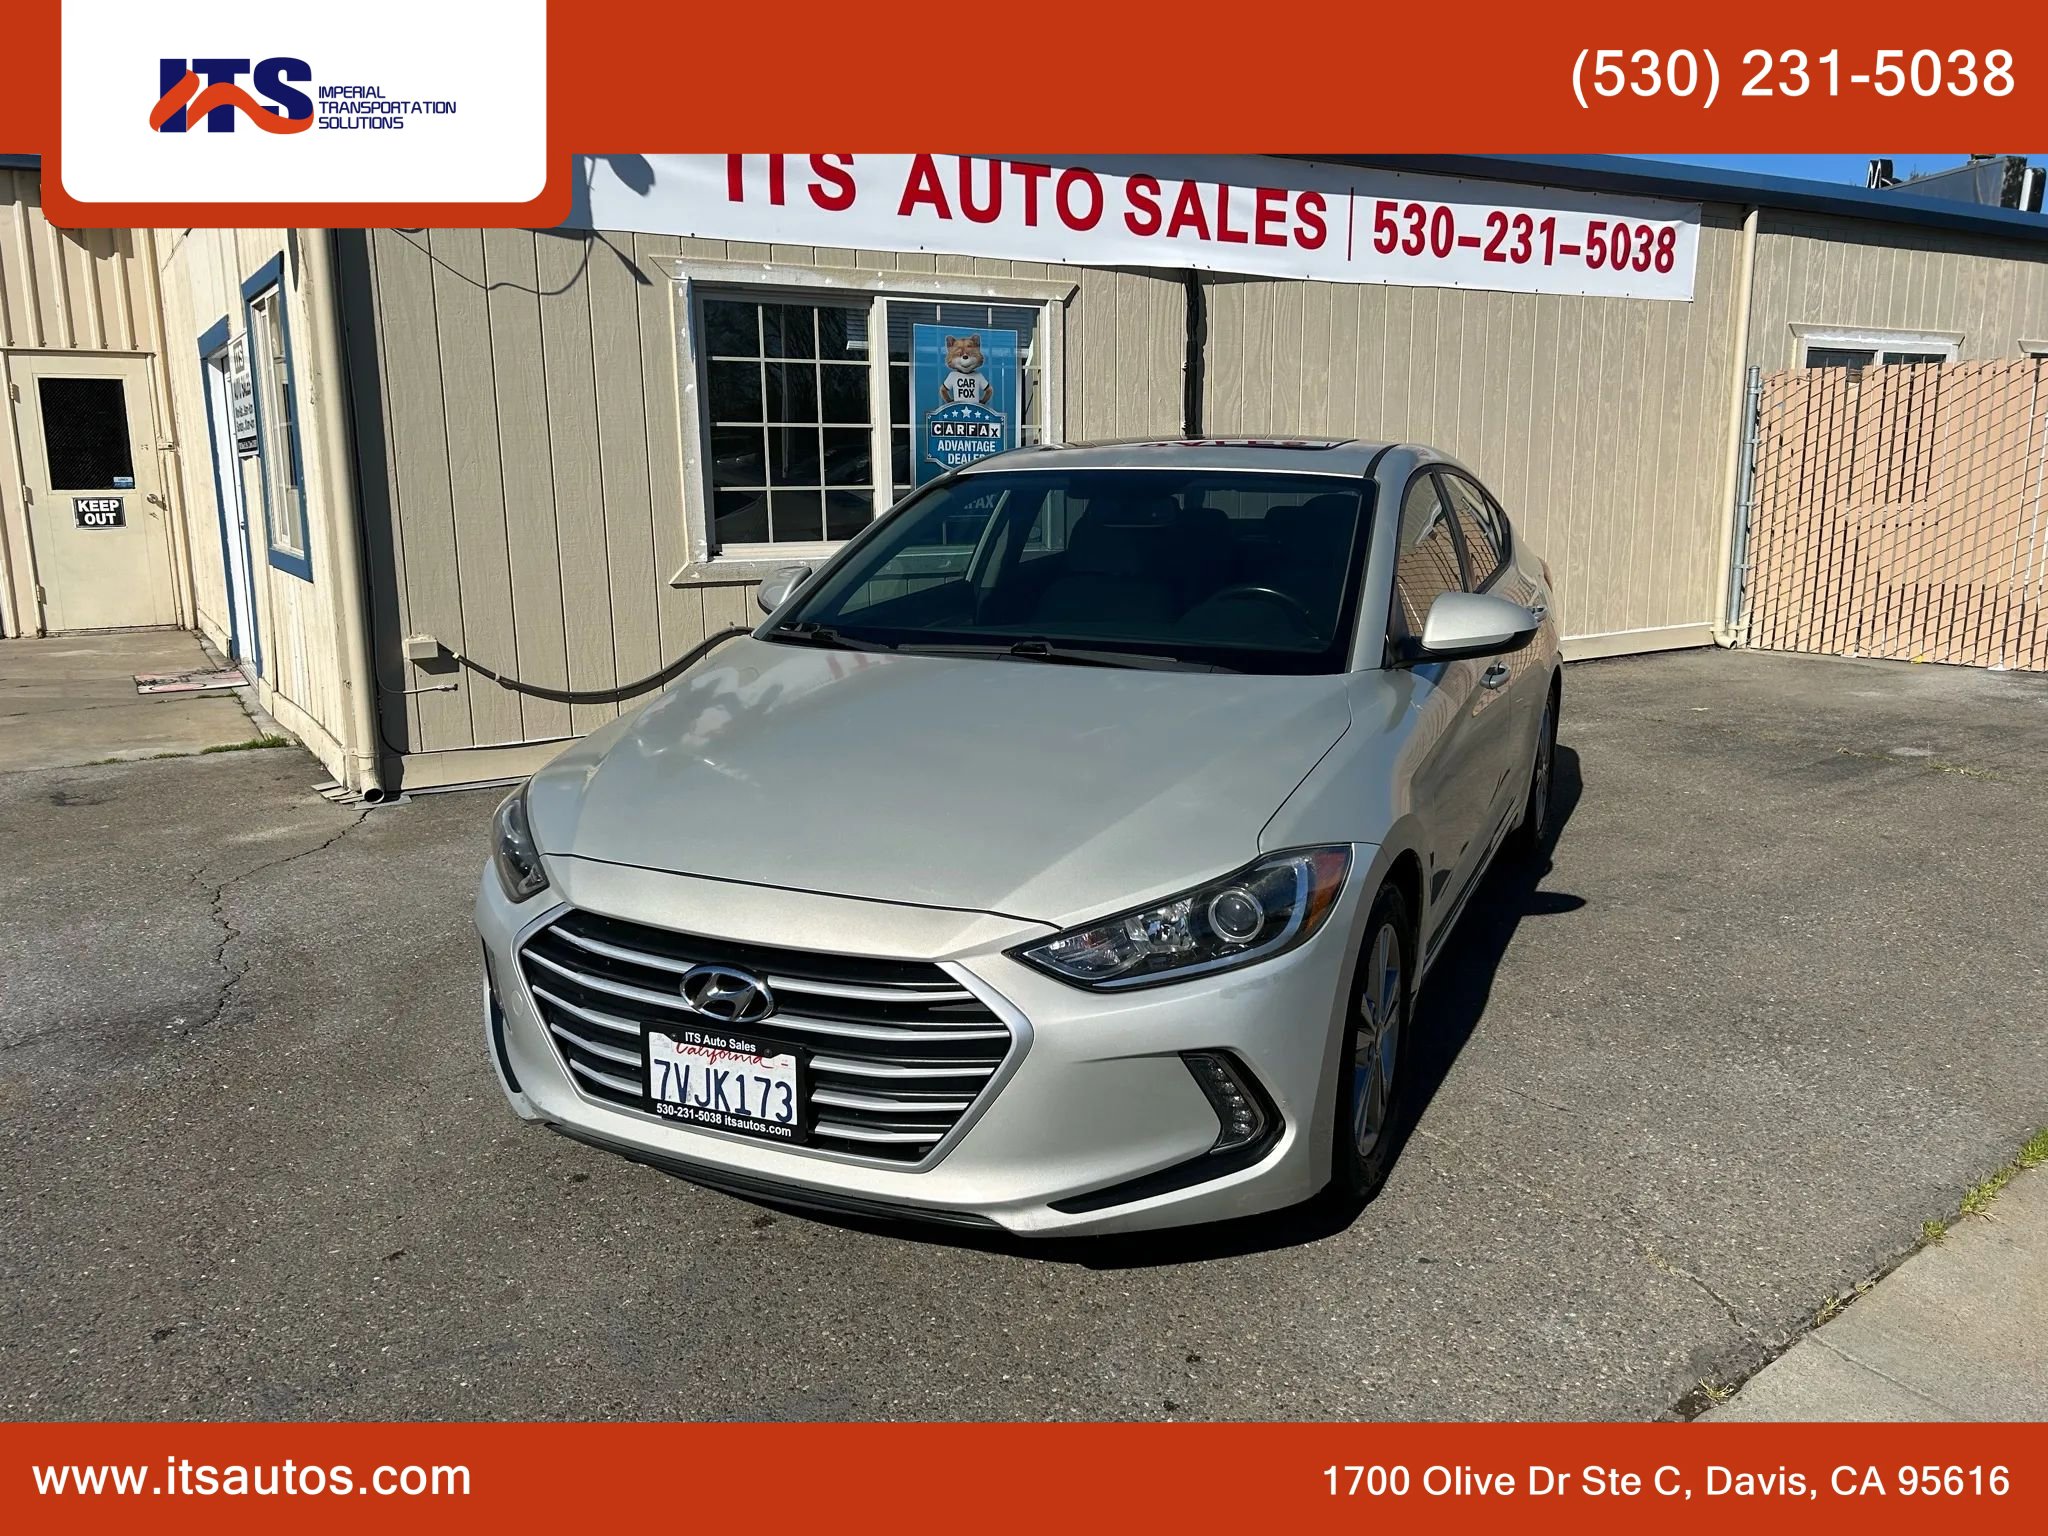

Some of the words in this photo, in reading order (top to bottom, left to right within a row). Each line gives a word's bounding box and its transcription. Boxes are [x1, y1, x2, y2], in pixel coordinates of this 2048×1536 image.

[897, 154, 1104, 232] AUTO
[1124, 174, 1327, 250] SALES
[1373, 200, 1677, 274] 530-231-5038
[957, 378, 976, 388] CAR
[958, 388, 976, 399] FOX
[932, 422, 1000, 438] CARFAX
[937, 440, 996, 453] ADVANTAGE
[77, 499, 120, 513] KEEP
[84, 512, 117, 526] OUT
[685, 1031, 702, 1044] ITS
[703, 1034, 727, 1048] Auto
[728, 1040, 757, 1053] Sales
[653, 1058, 793, 1124] 7VJK173
[656, 1102, 722, 1125] 530-231-5038
[724, 1114, 792, 1138] itsautos.com
